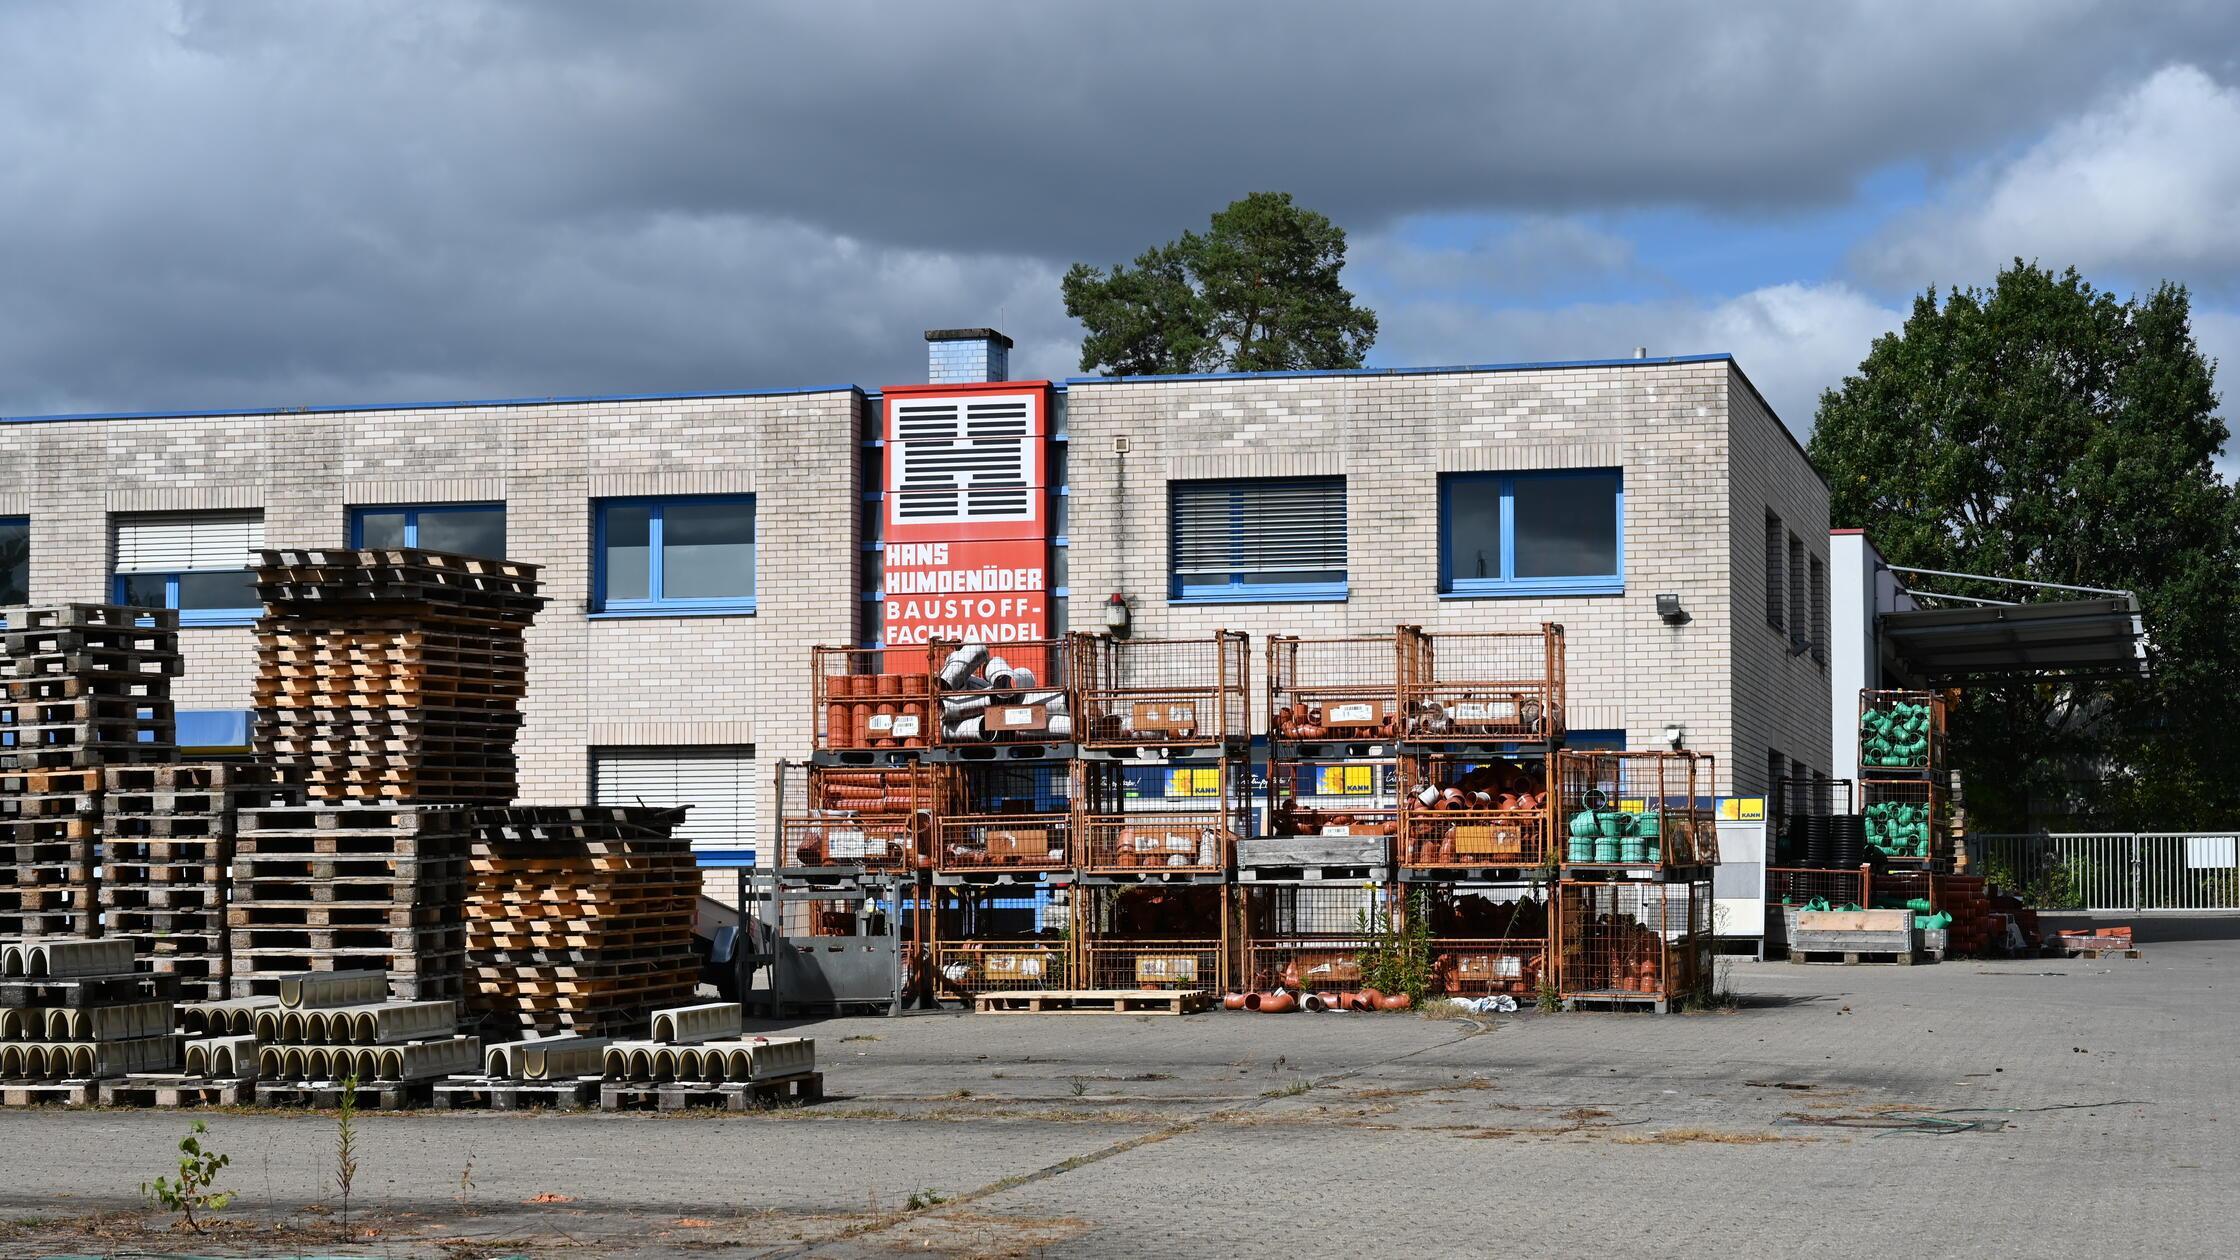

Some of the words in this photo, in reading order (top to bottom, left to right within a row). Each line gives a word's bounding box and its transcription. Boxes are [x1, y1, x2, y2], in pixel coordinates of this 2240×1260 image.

[886, 544, 949, 566] HANS
[887, 598, 1041, 620] BAUSTOFF-
[887, 623, 1042, 644] FACHHANDEL
